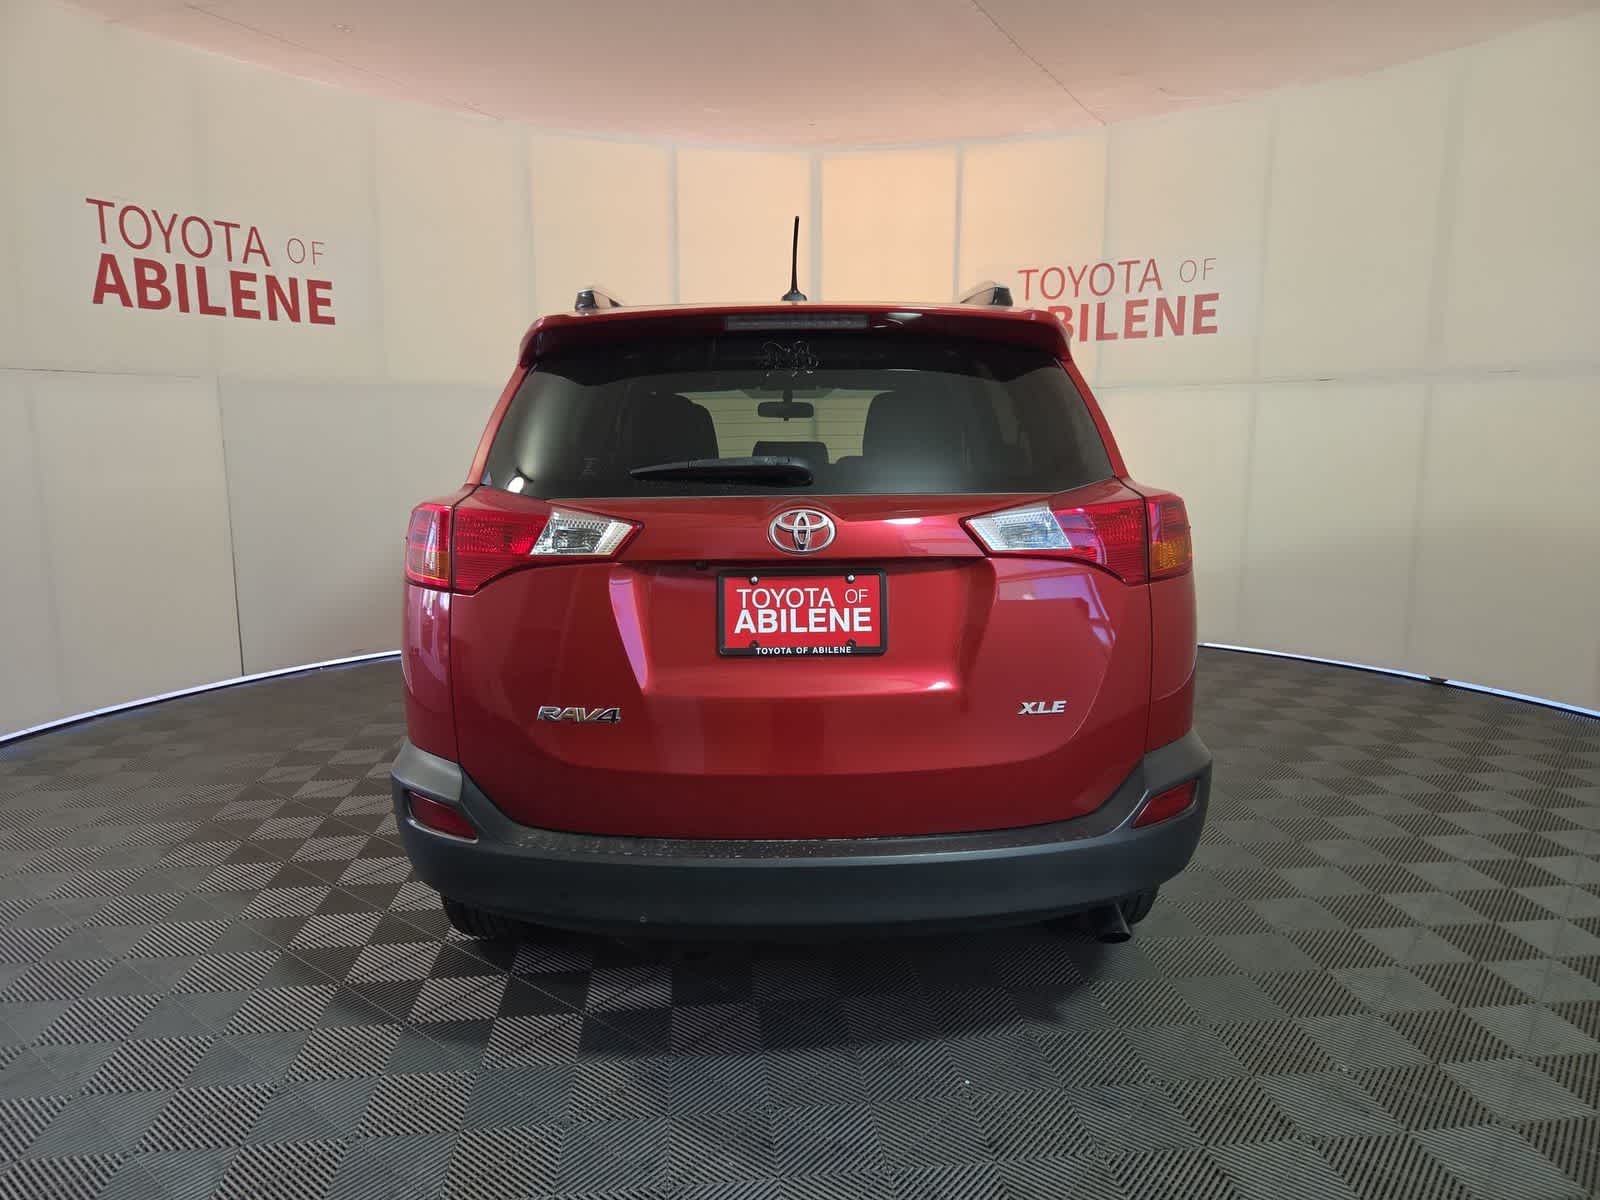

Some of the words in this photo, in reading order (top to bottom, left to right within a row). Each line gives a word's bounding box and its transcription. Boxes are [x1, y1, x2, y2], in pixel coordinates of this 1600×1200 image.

[86, 198, 271, 267] TOYOTA
[286, 238, 325, 265] OF
[92, 253, 336, 325] ABILENE
[1017, 258, 1162, 301] TOYOTA
[1179, 257, 1217, 283] OF
[1048, 292, 1220, 343] BILENE
[736, 587, 835, 609] TOYOTA
[844, 588, 869, 604] OF
[734, 607, 873, 634] ABILENE
[756, 647, 792, 655] TOYOTA
[795, 647, 809, 655] OF
[812, 646, 852, 655] ABILENE
[536, 706, 622, 724] RAV4
[1017, 700, 1067, 715] XLE
